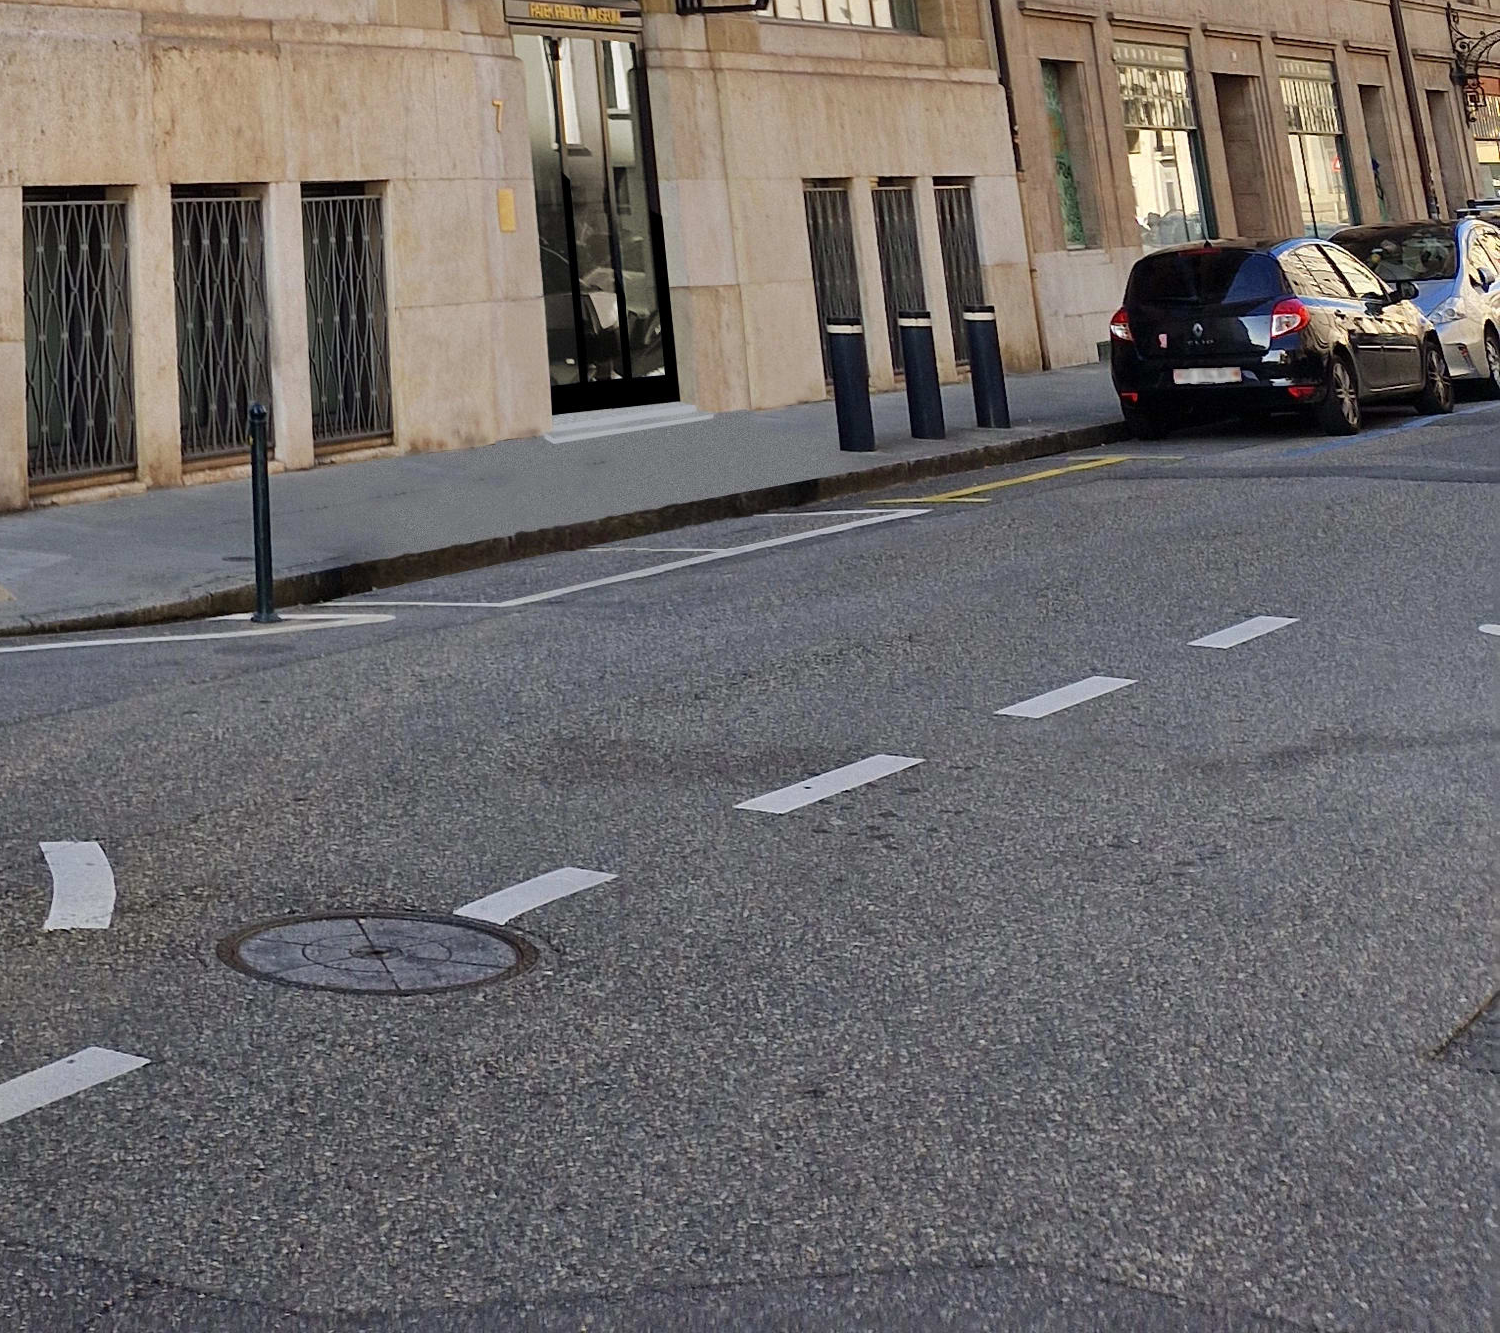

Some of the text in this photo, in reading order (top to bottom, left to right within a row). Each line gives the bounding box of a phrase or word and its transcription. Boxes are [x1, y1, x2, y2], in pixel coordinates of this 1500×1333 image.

[529, 2, 620, 24] PATEK PHILIPPE MUSEUM
[492, 100, 503, 133] 7
